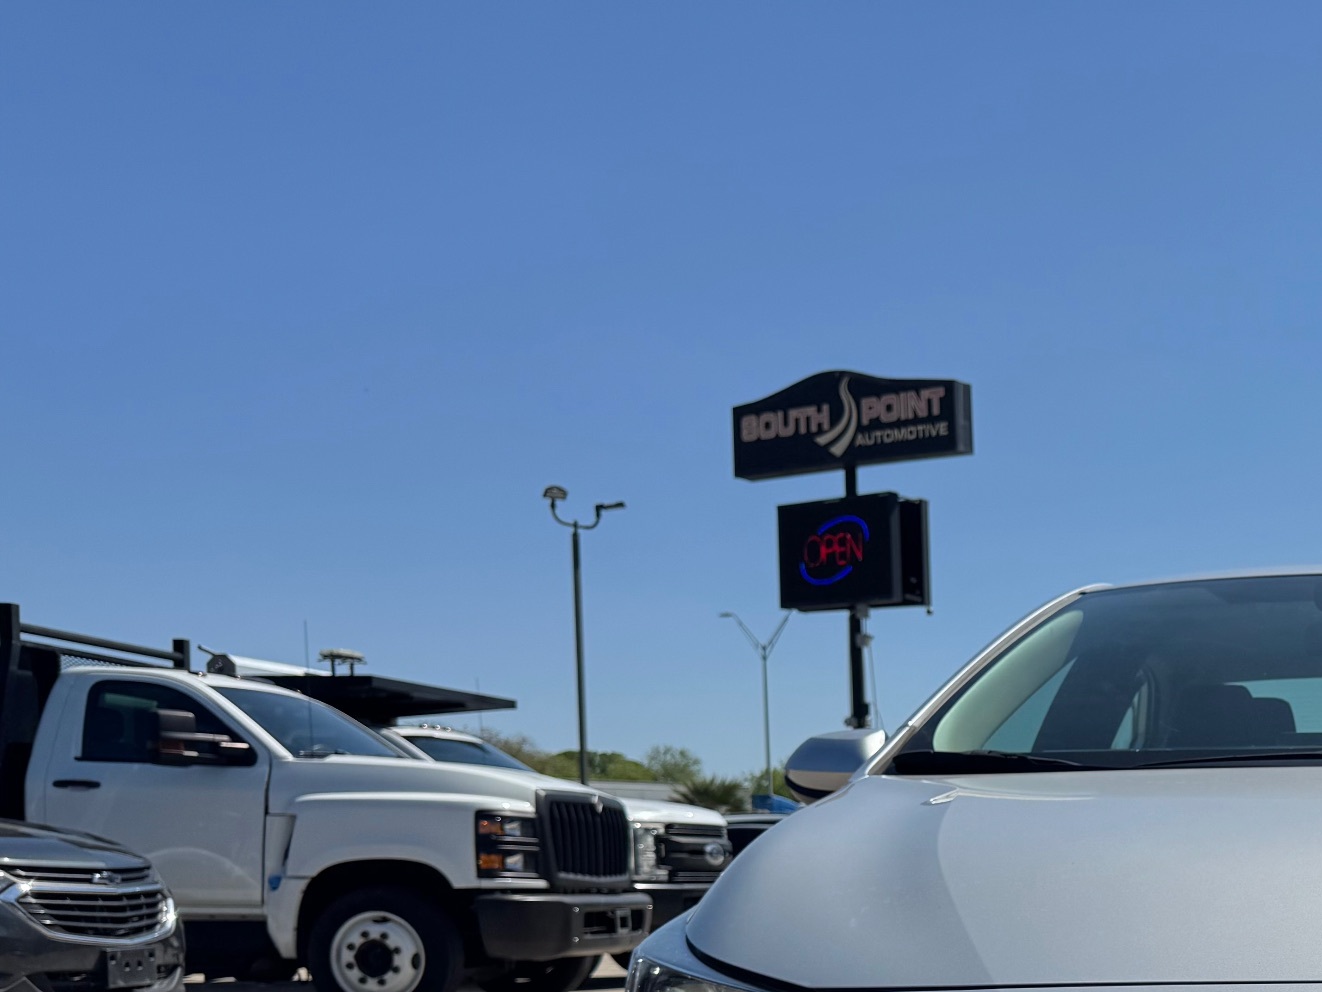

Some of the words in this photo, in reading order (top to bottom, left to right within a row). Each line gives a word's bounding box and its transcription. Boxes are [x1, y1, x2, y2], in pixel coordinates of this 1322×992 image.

[740, 403, 831, 443] SOUTH
[861, 386, 946, 426] POINT
[855, 421, 949, 447] AUTOMOTIVE
[804, 532, 863, 567] OPEN
